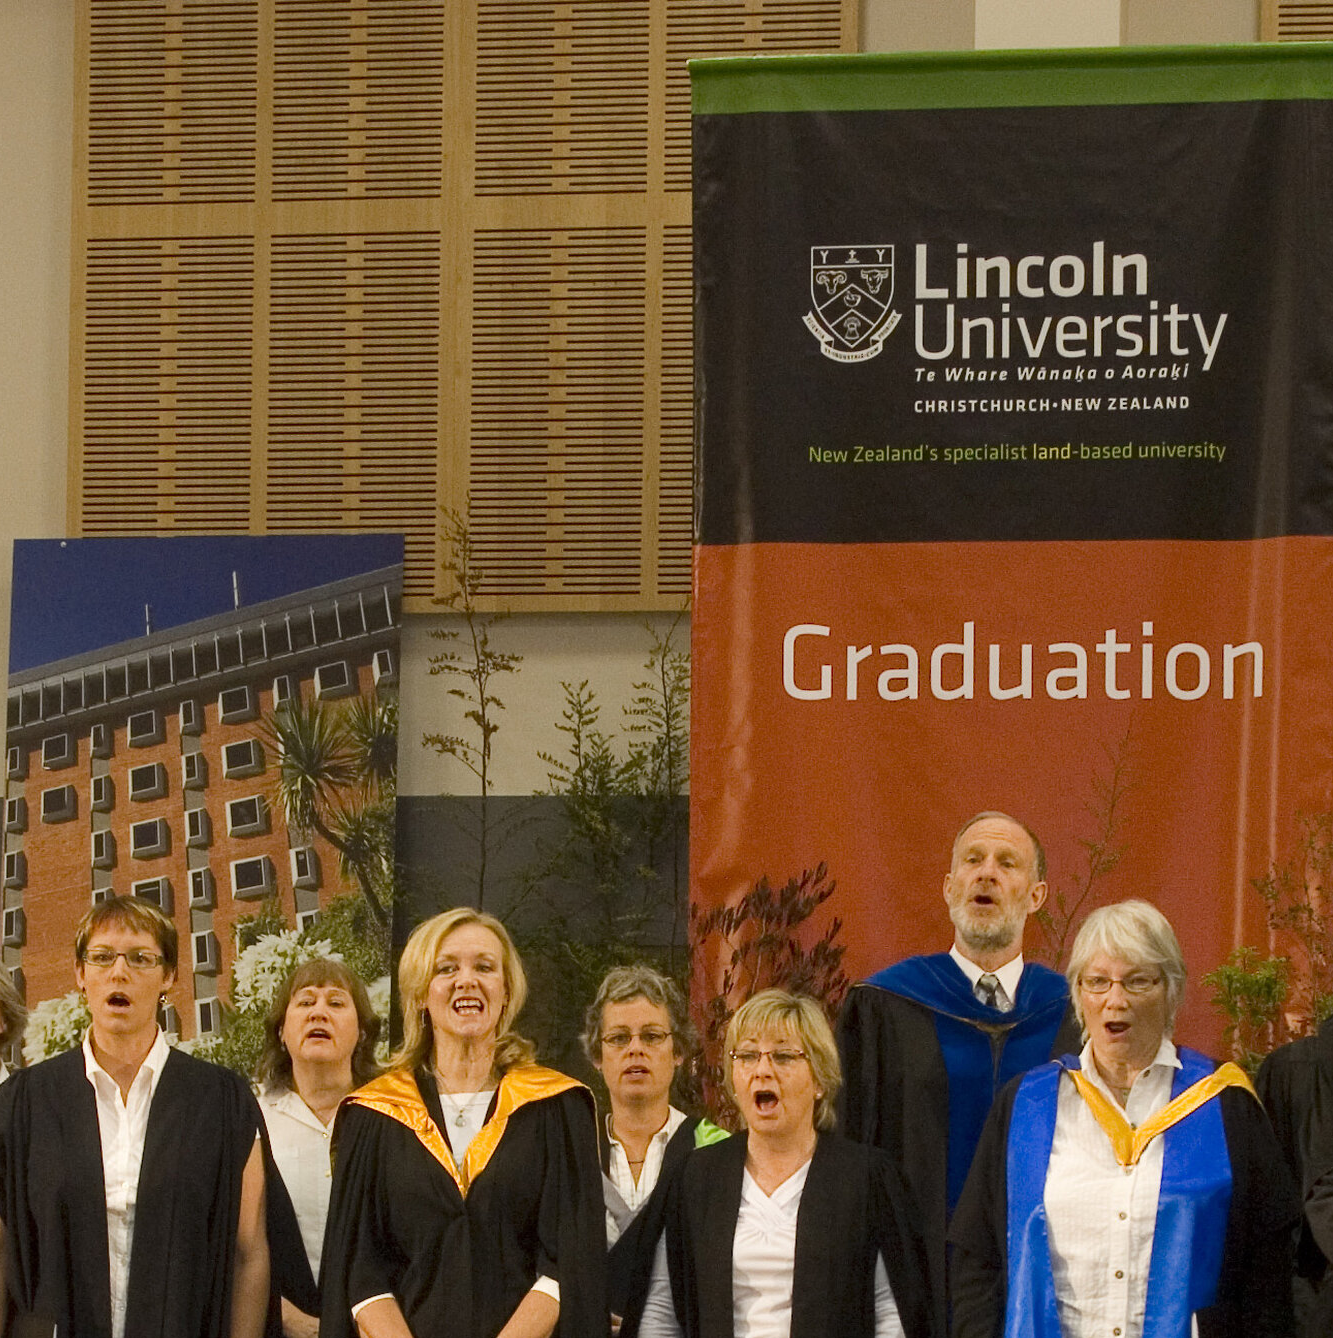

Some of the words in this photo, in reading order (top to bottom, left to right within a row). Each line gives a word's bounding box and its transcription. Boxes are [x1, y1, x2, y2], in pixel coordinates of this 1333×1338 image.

[915, 241, 1148, 299] Lincoln
[914, 301, 1228, 371] University
[914, 367, 936, 382] Te
[945, 367, 1008, 382] Whare
[1104, 368, 1115, 380] o
[1107, 396, 1189, 411] ZEALAND
[809, 446, 848, 463] New
[853, 444, 938, 463] Zealand's
[944, 443, 1027, 465] specialist
[1033, 441, 1132, 460] land-based
[1138, 441, 1226, 463] university
[784, 621, 1264, 701] Graduation
